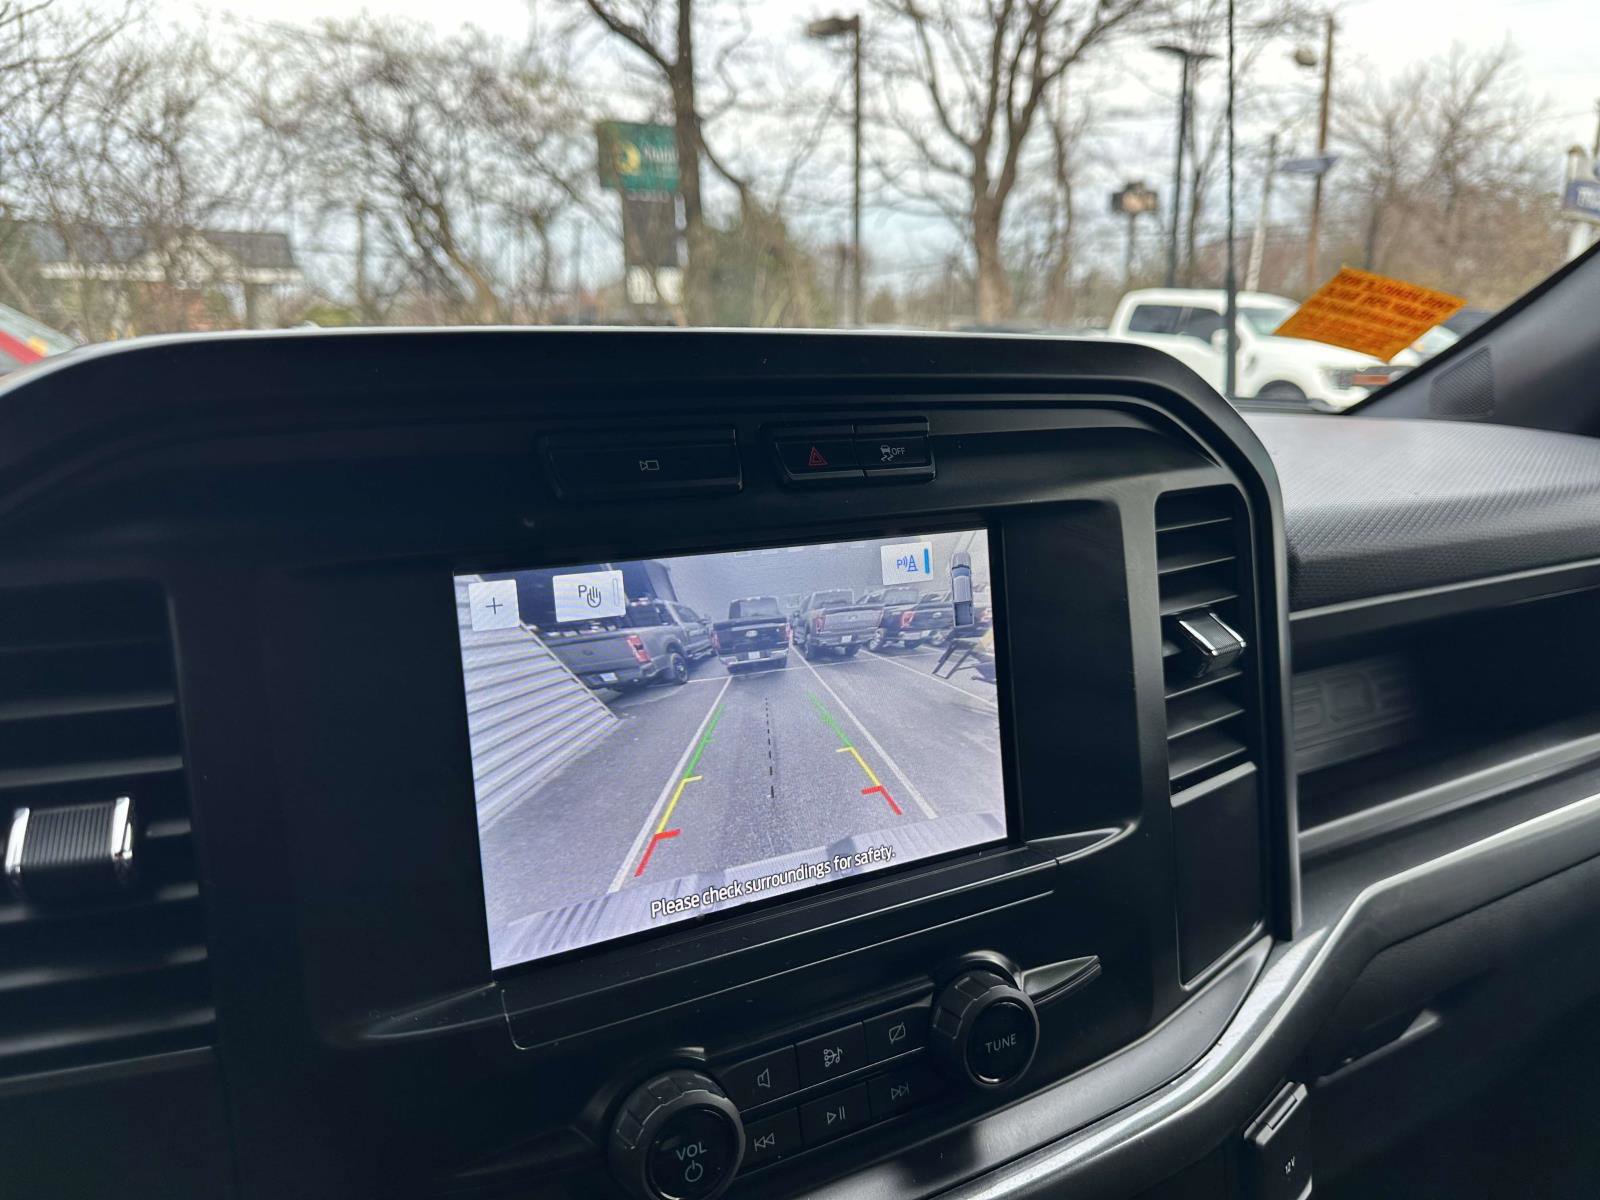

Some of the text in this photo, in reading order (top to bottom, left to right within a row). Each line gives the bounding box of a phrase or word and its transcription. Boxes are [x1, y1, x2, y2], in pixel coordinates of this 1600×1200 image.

[891, 447, 905, 456] OFF
[651, 845, 896, 918] Please check surroundings for safety.
[985, 1032, 1017, 1054] TUNE
[675, 1141, 708, 1161] VOL
